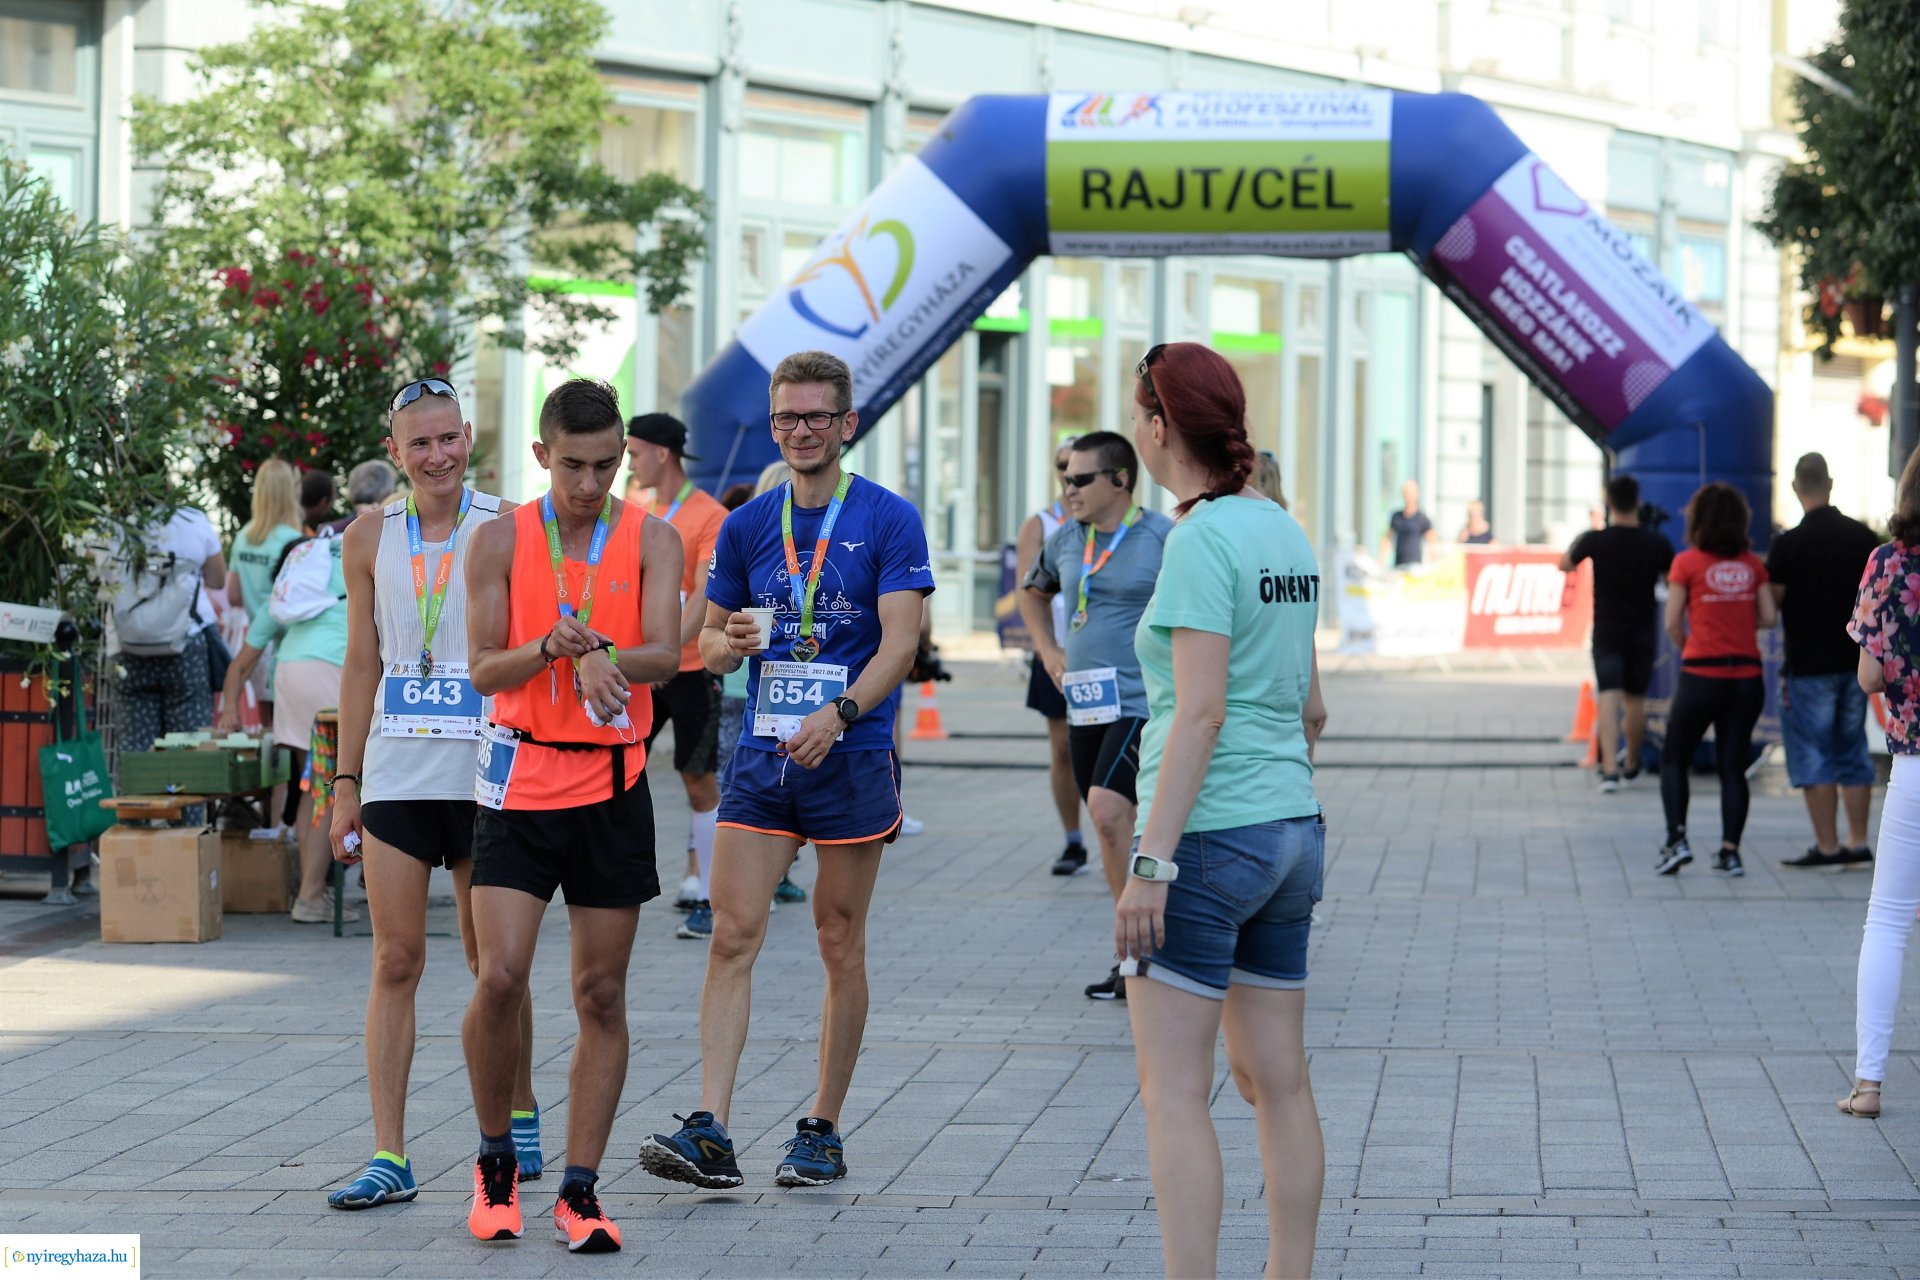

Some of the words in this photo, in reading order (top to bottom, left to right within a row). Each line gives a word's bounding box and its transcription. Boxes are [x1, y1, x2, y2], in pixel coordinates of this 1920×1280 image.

[1081, 154, 1354, 212] RAJT/CÉL
[1499, 266, 1594, 363] HOZZÁNK
[1505, 235, 1627, 358] CSATLAKOZZ
[402, 680, 462, 705] 643
[769, 680, 824, 706] 654
[1071, 682, 1103, 703] 639
